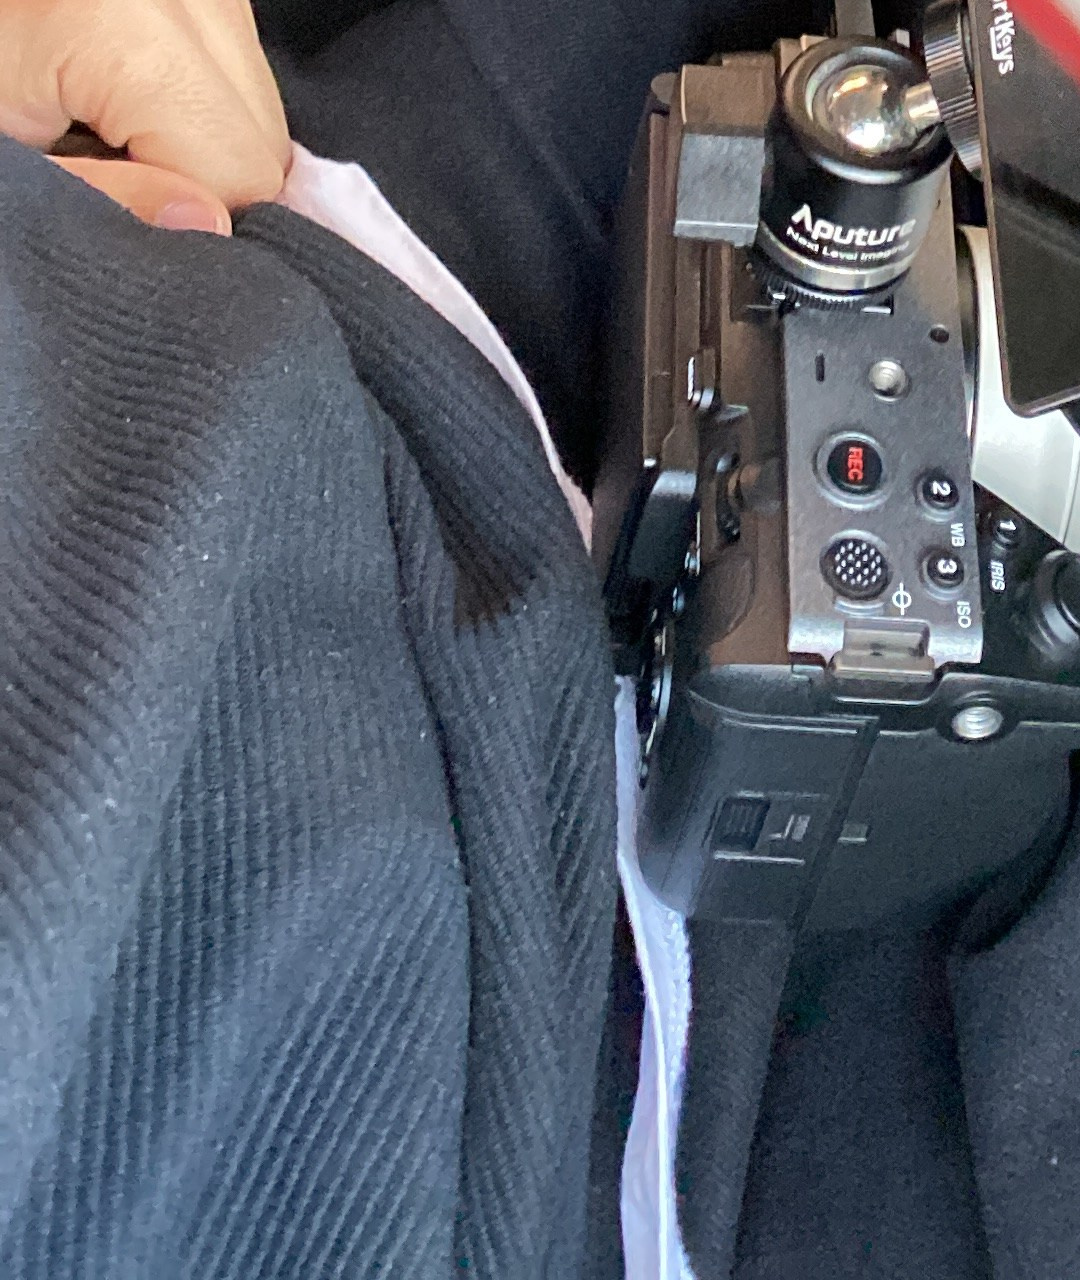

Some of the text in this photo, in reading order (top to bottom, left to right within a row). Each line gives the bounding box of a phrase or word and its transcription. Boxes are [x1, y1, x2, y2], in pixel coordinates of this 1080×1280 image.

[847, 446, 864, 482] REC
[931, 480, 952, 496] 2
[950, 522, 966, 547] WB
[999, 519, 1017, 532] 1
[937, 559, 957, 574] 3
[990, 559, 1006, 592] IRIS
[956, 600, 972, 629] ISO
